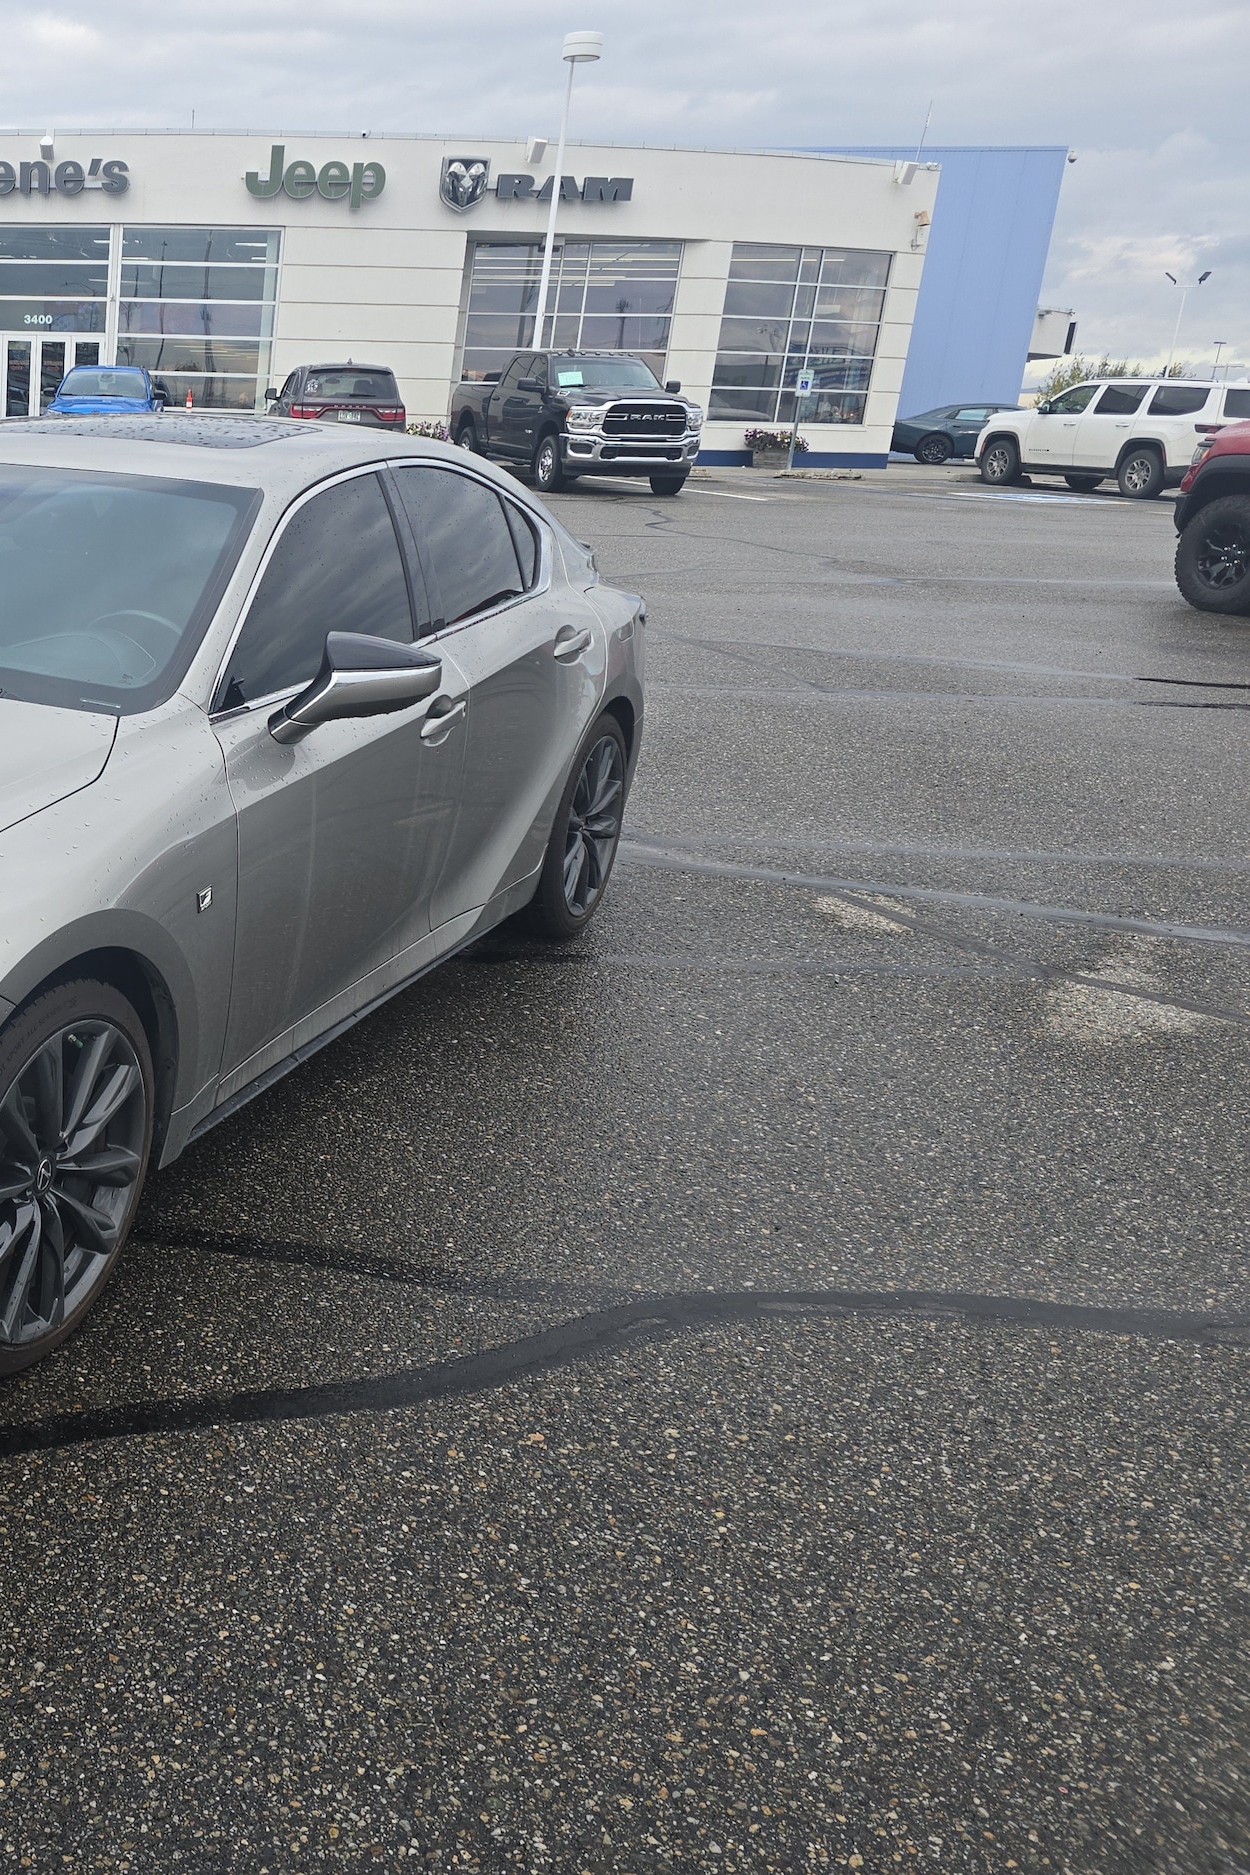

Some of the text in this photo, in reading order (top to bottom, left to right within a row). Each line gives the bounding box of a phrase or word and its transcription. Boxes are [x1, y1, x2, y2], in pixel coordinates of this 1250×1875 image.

[245, 145, 386, 208] Jeep
[497, 174, 634, 201] RAM
[23, 314, 53, 325] 3400
